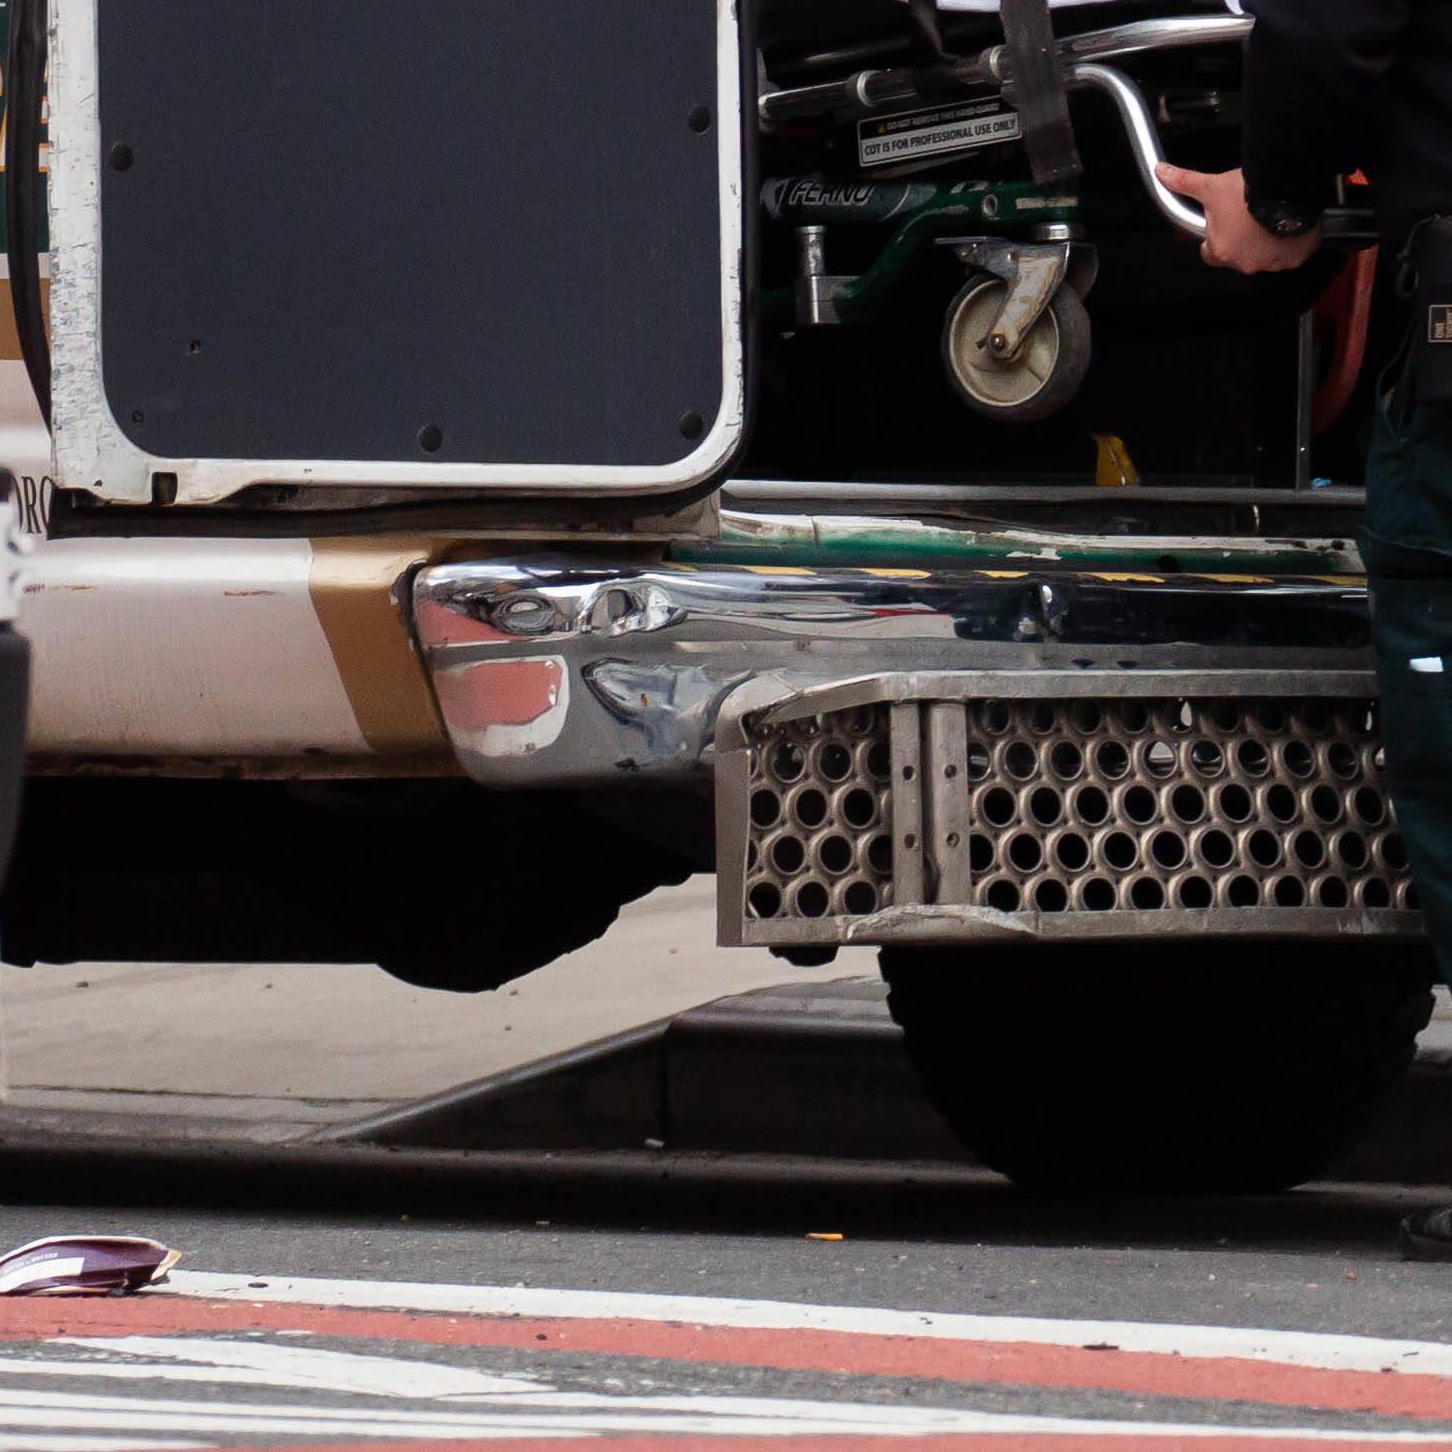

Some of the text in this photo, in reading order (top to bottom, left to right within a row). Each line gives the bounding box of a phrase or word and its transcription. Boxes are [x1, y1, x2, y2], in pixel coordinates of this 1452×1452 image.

[892, 139, 909, 151] FOR
[910, 126, 974, 148] PROFESSIONAL
[975, 123, 991, 135] USE
